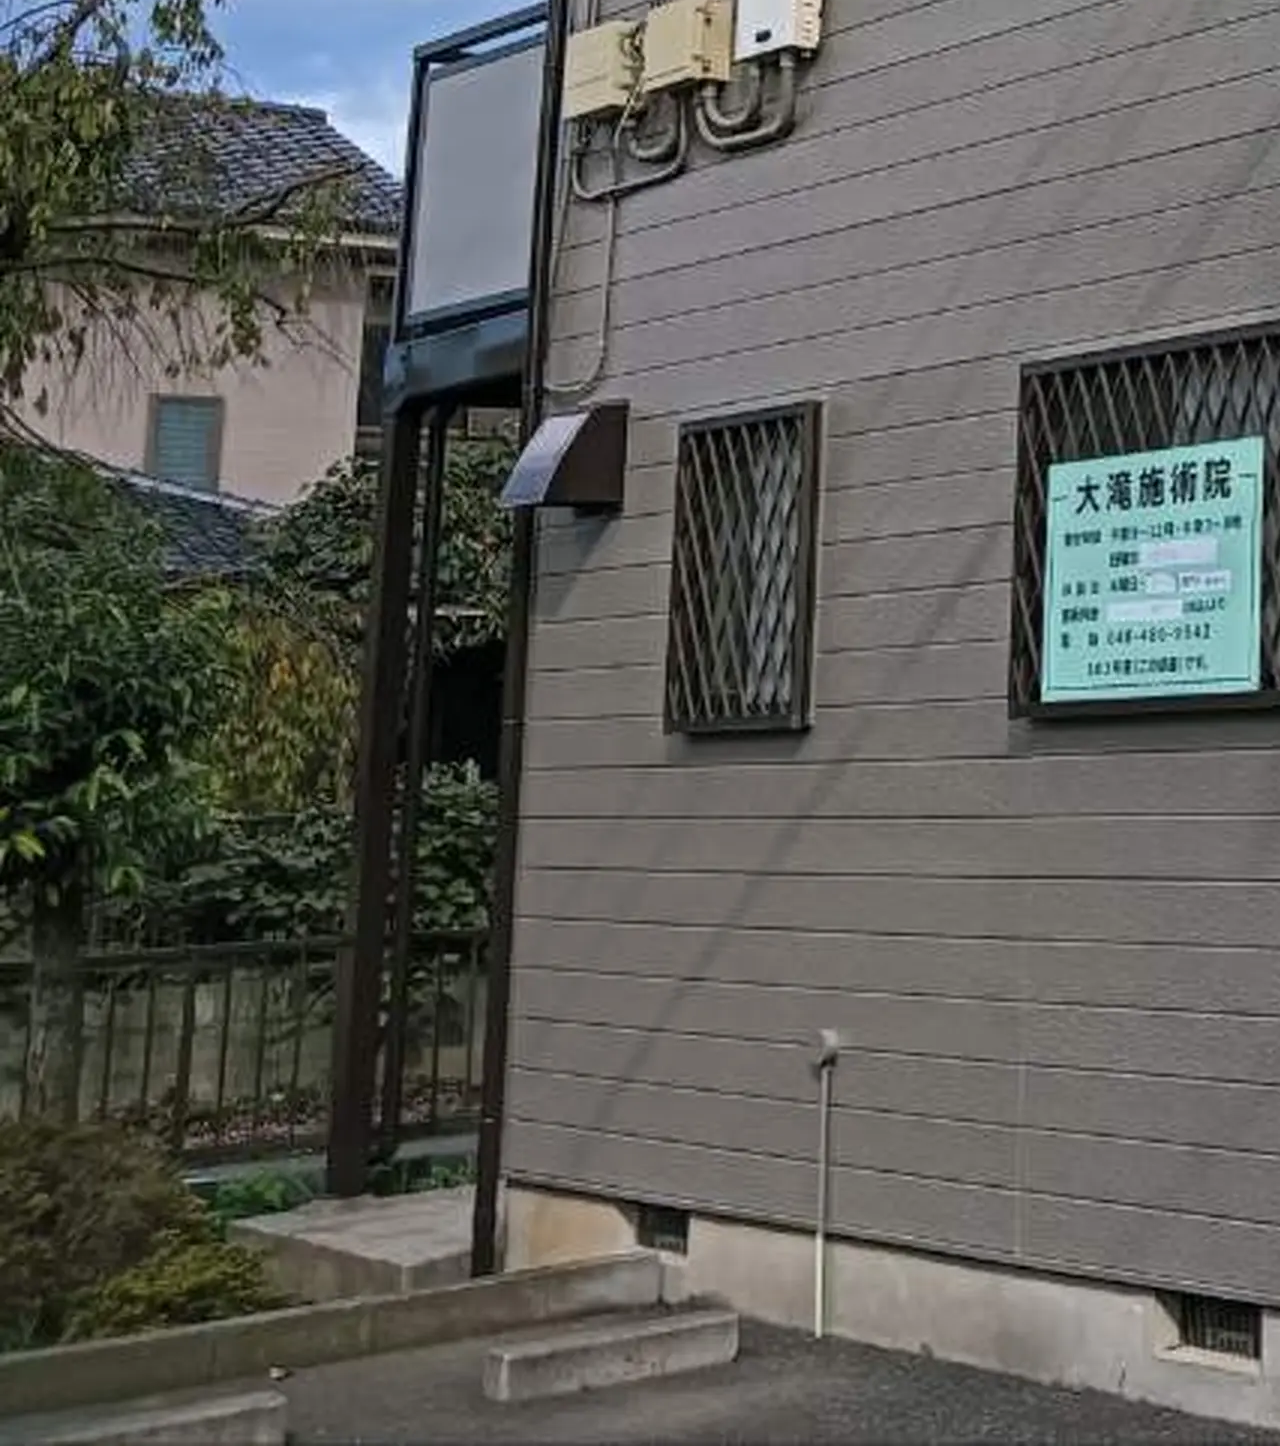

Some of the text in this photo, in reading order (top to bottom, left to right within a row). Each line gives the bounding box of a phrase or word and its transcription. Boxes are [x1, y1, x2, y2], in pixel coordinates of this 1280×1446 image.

[1075, 457, 1233, 515] 大滝施術院
